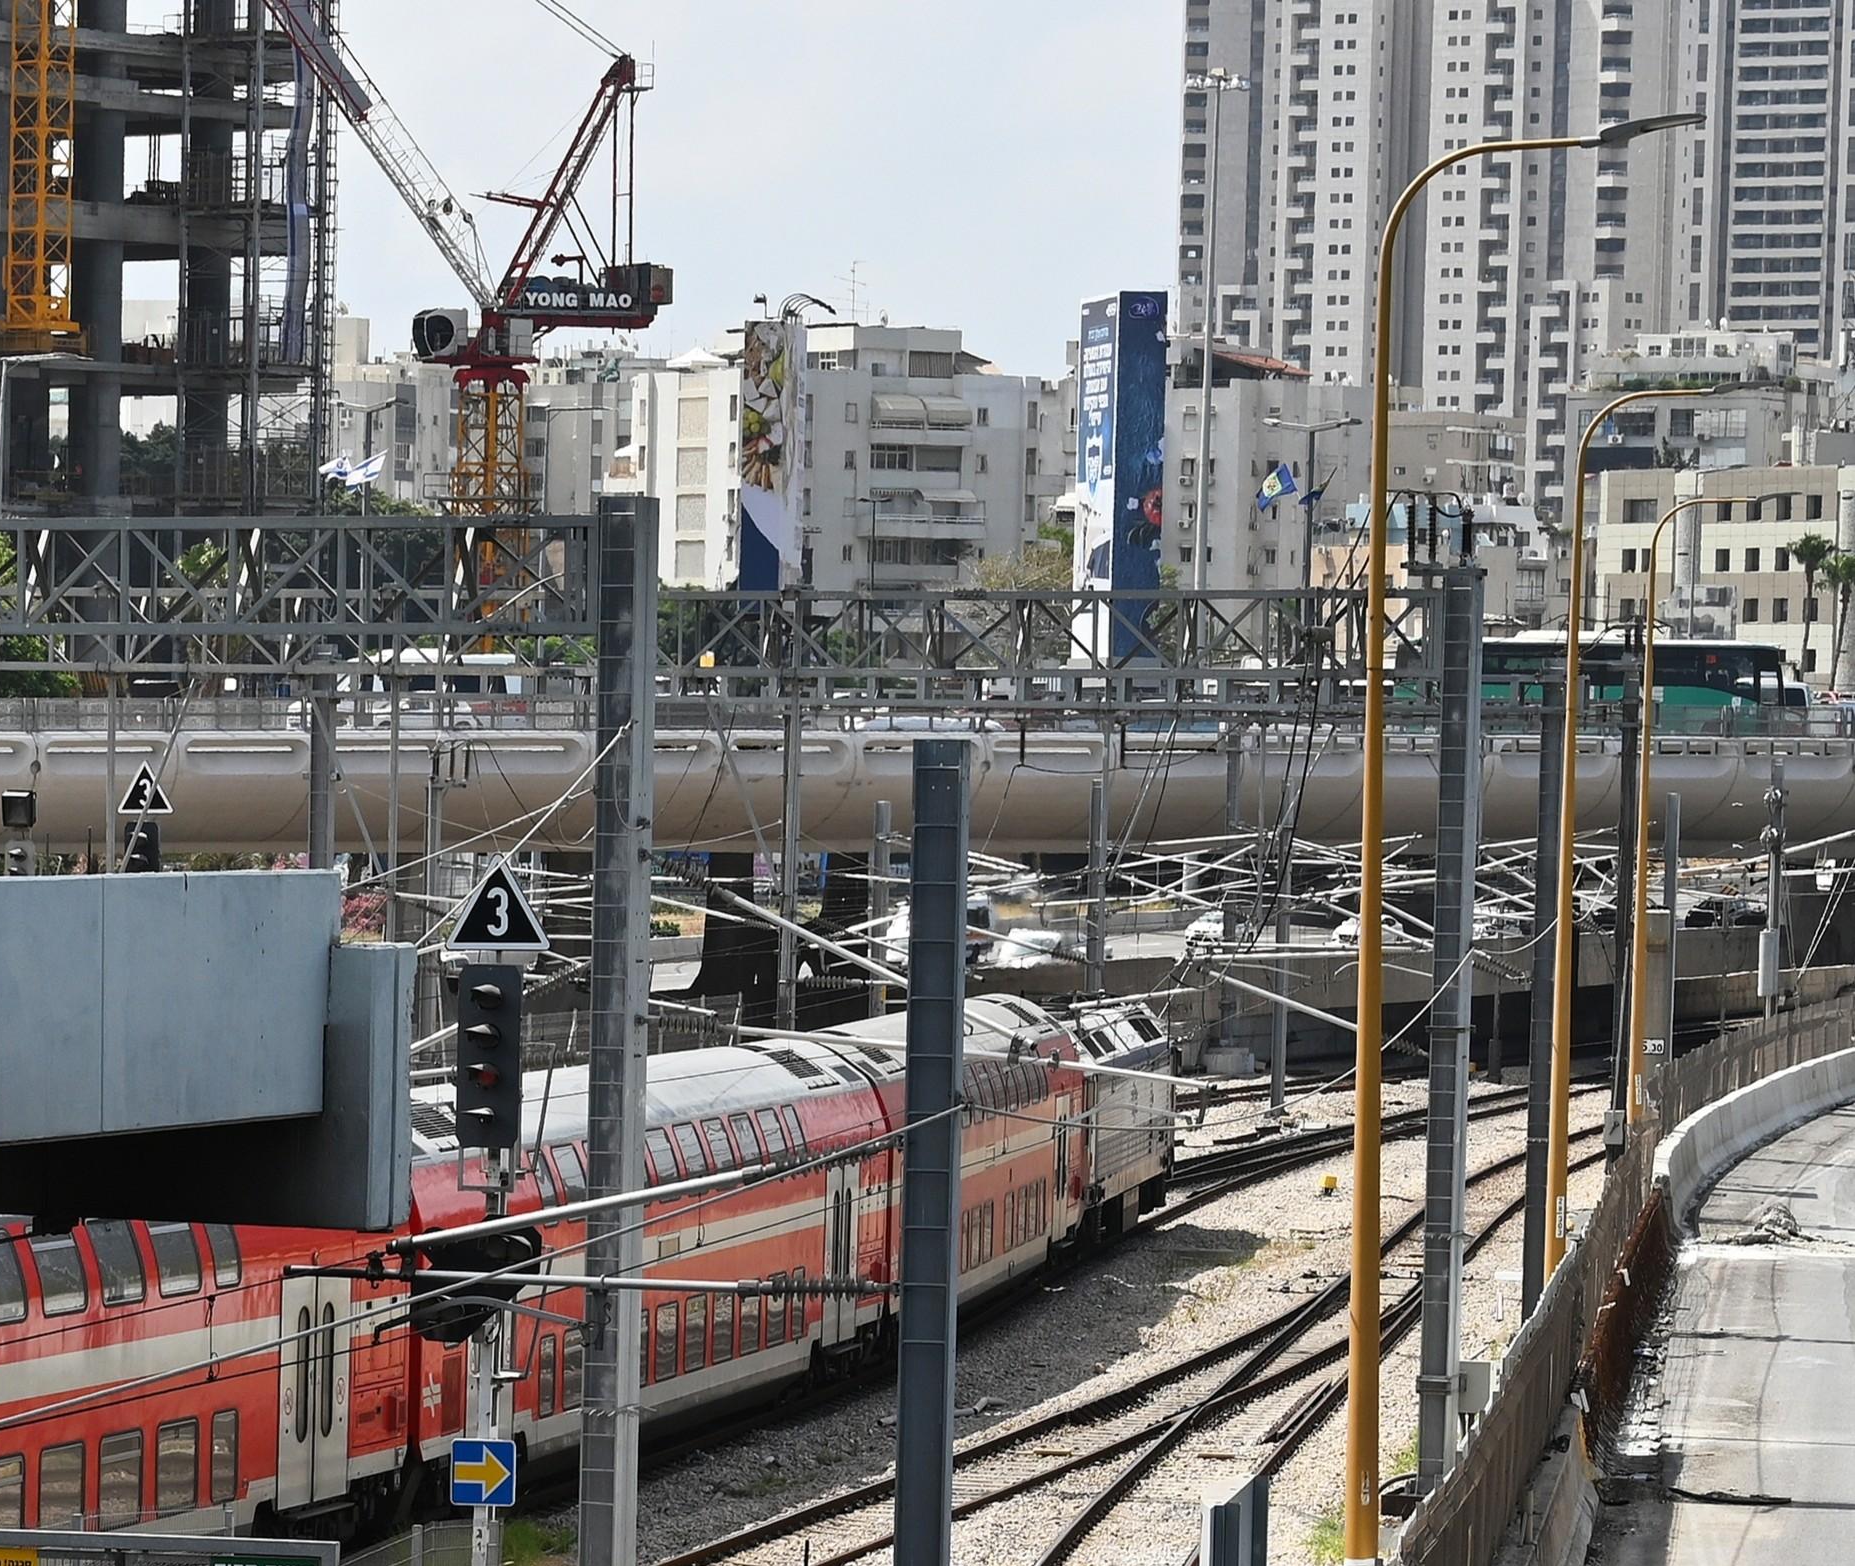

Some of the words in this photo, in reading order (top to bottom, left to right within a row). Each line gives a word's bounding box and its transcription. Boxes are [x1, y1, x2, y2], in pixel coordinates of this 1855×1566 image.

[525, 291, 578, 307] YONG
[589, 292, 633, 308] MAO
[486, 886, 510, 938] 3
